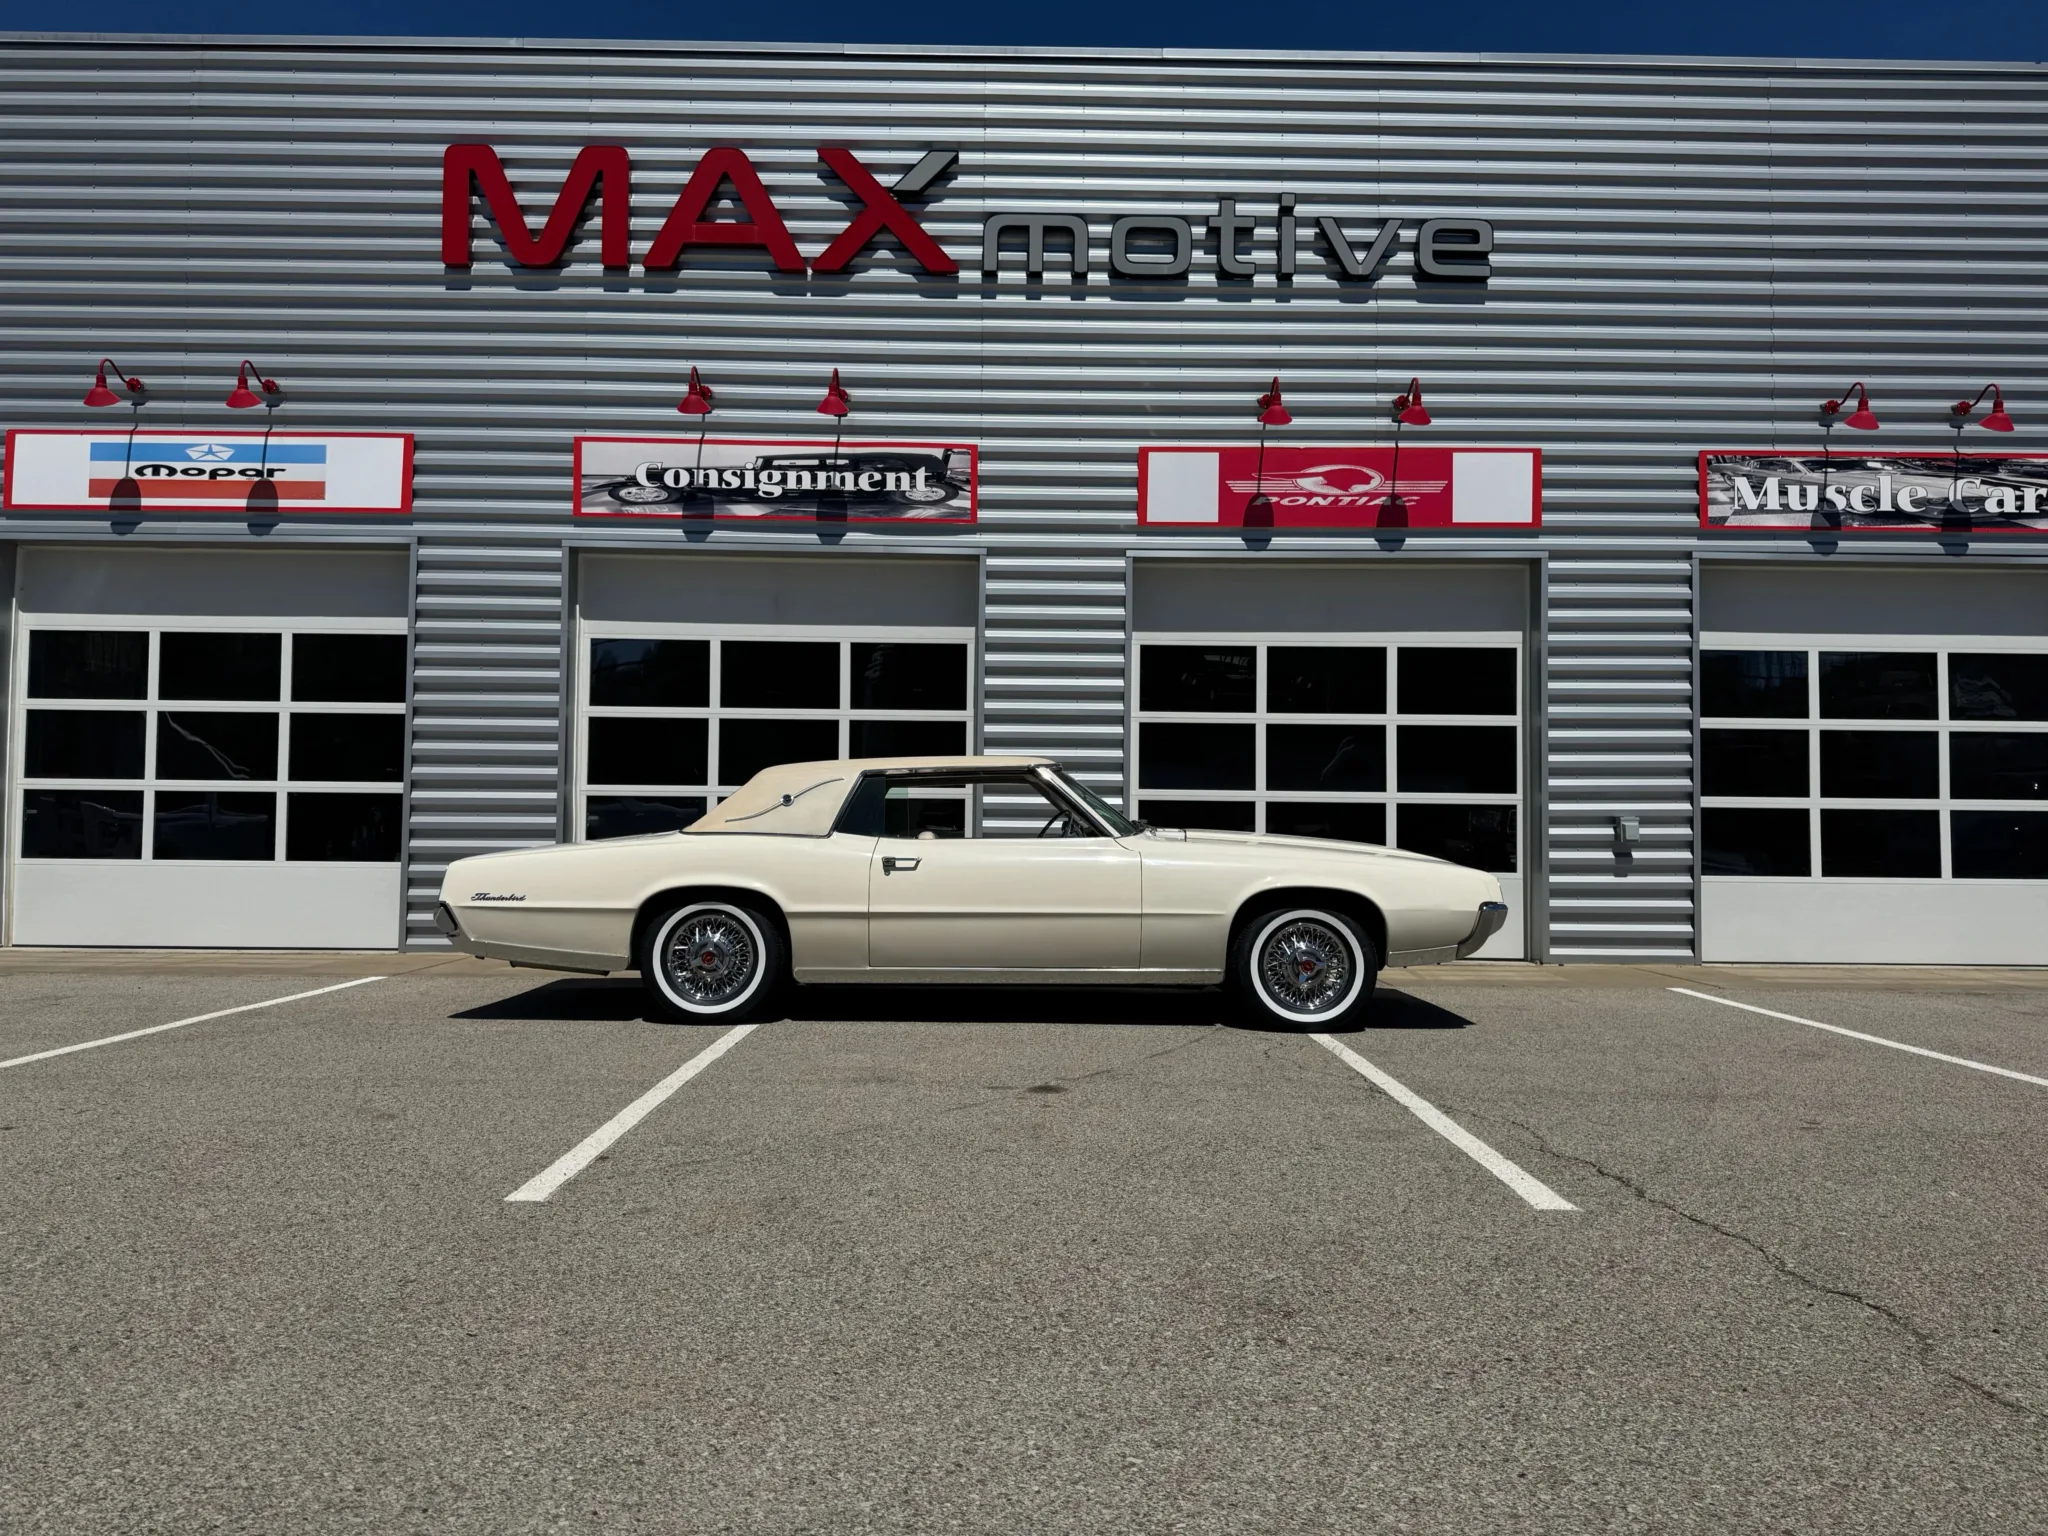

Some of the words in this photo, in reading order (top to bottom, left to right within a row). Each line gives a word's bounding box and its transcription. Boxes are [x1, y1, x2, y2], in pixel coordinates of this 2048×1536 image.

[134, 463, 287, 480] Mopar
[634, 461, 933, 498] Consignment
[1252, 495, 1421, 507] PONTIAC
[1731, 474, 1929, 513] Muscle
[470, 892, 527, 902] Thunderbird
